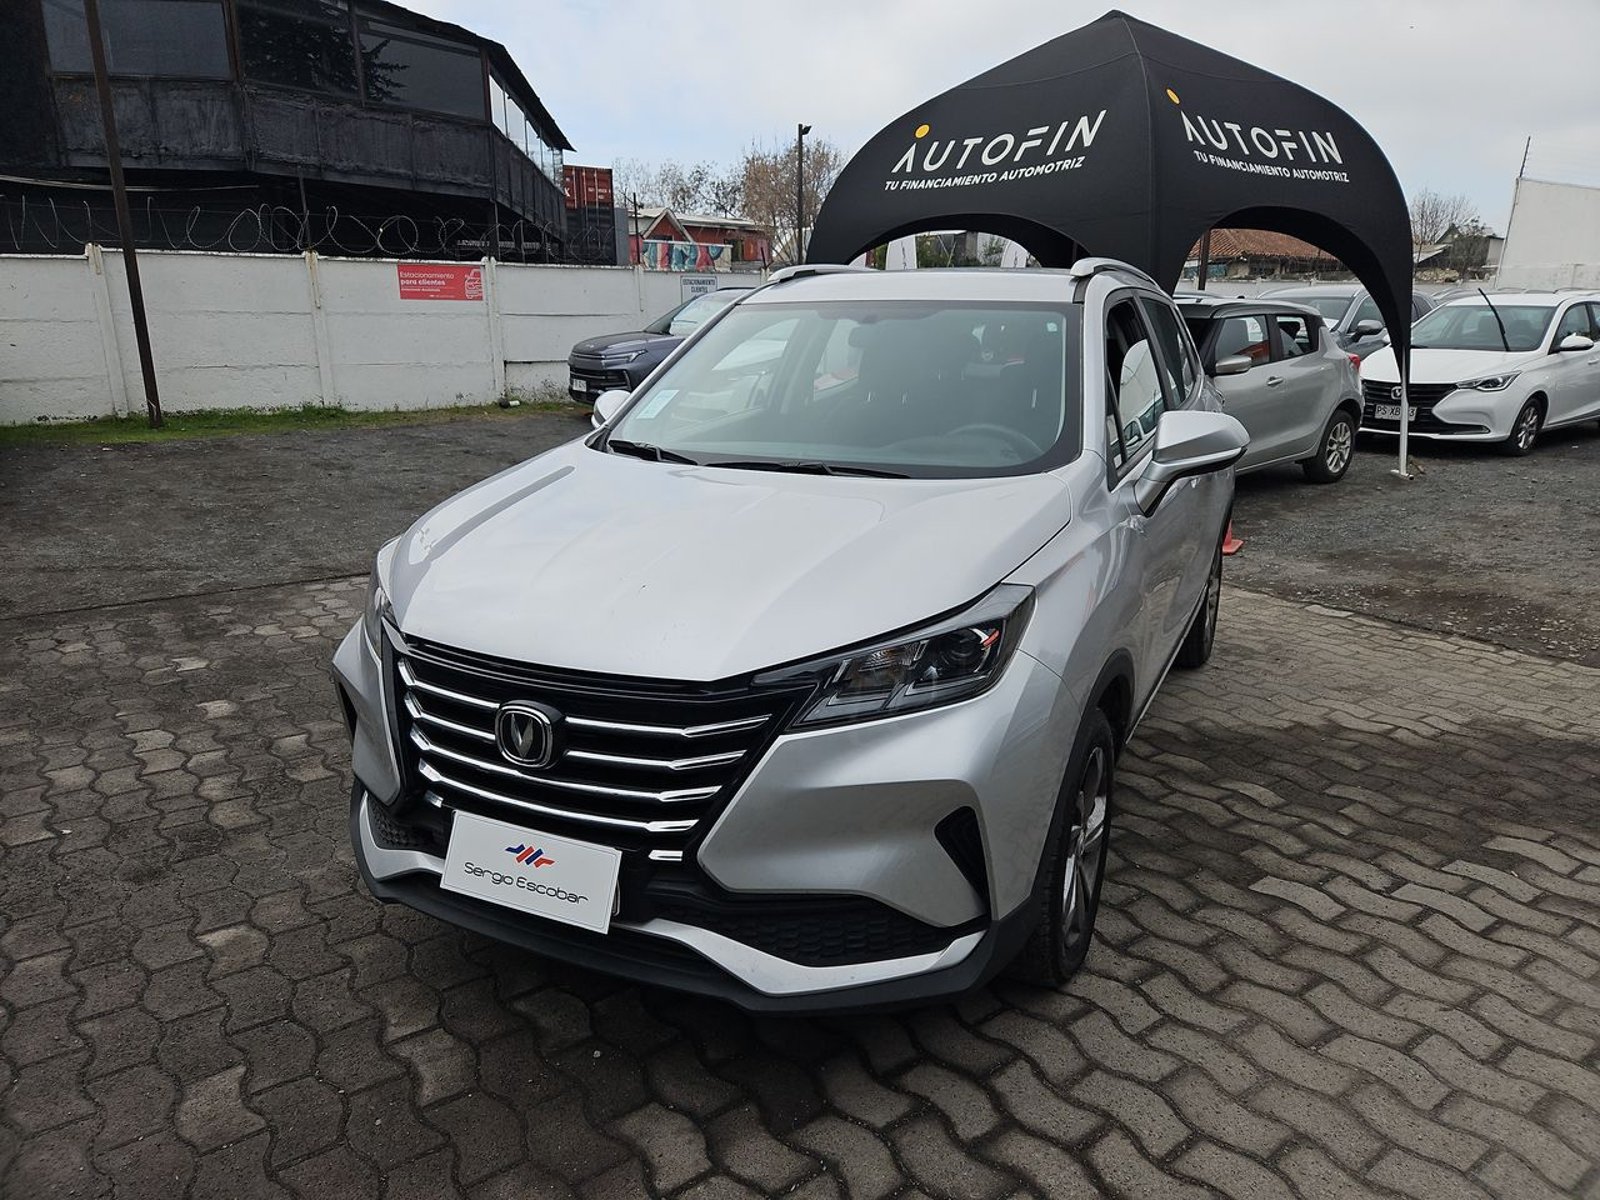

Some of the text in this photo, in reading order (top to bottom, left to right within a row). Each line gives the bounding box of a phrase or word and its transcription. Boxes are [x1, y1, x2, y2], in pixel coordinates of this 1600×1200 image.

[891, 109, 1107, 173] AUTOFIN
[1180, 109, 1343, 165] AUTOFIN
[884, 155, 1086, 191] TU FINANCIAMIENTO AUTOMOTRIZ
[1193, 149, 1350, 183] TU FINANCIAMIENTO AUTOMOTRIZ
[399, 271, 455, 280] Estacionamiento
[418, 278, 446, 286] clientes
[515, 876, 589, 904] Escobar
